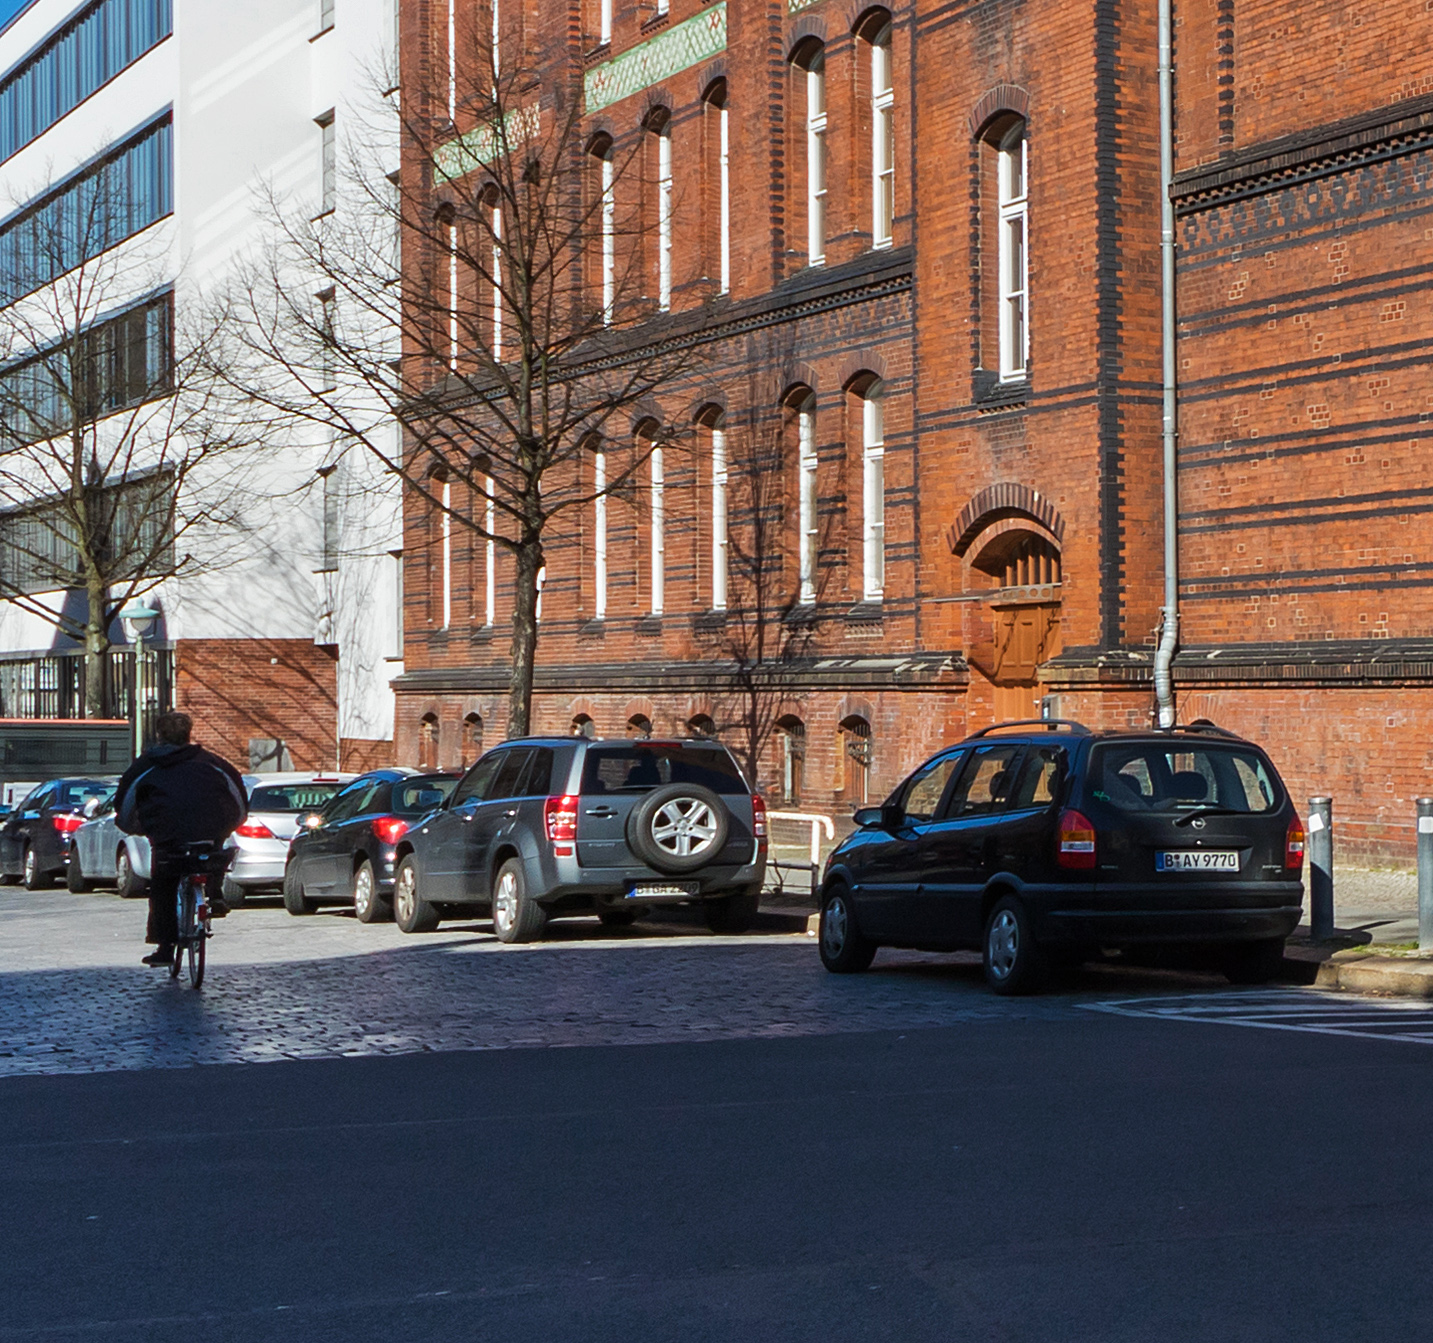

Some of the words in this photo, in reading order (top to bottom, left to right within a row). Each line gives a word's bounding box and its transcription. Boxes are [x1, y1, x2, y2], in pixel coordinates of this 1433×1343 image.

[1164, 853, 1175, 868] B
[1183, 853, 1200, 868] AY
[1203, 853, 1237, 867] 9770
